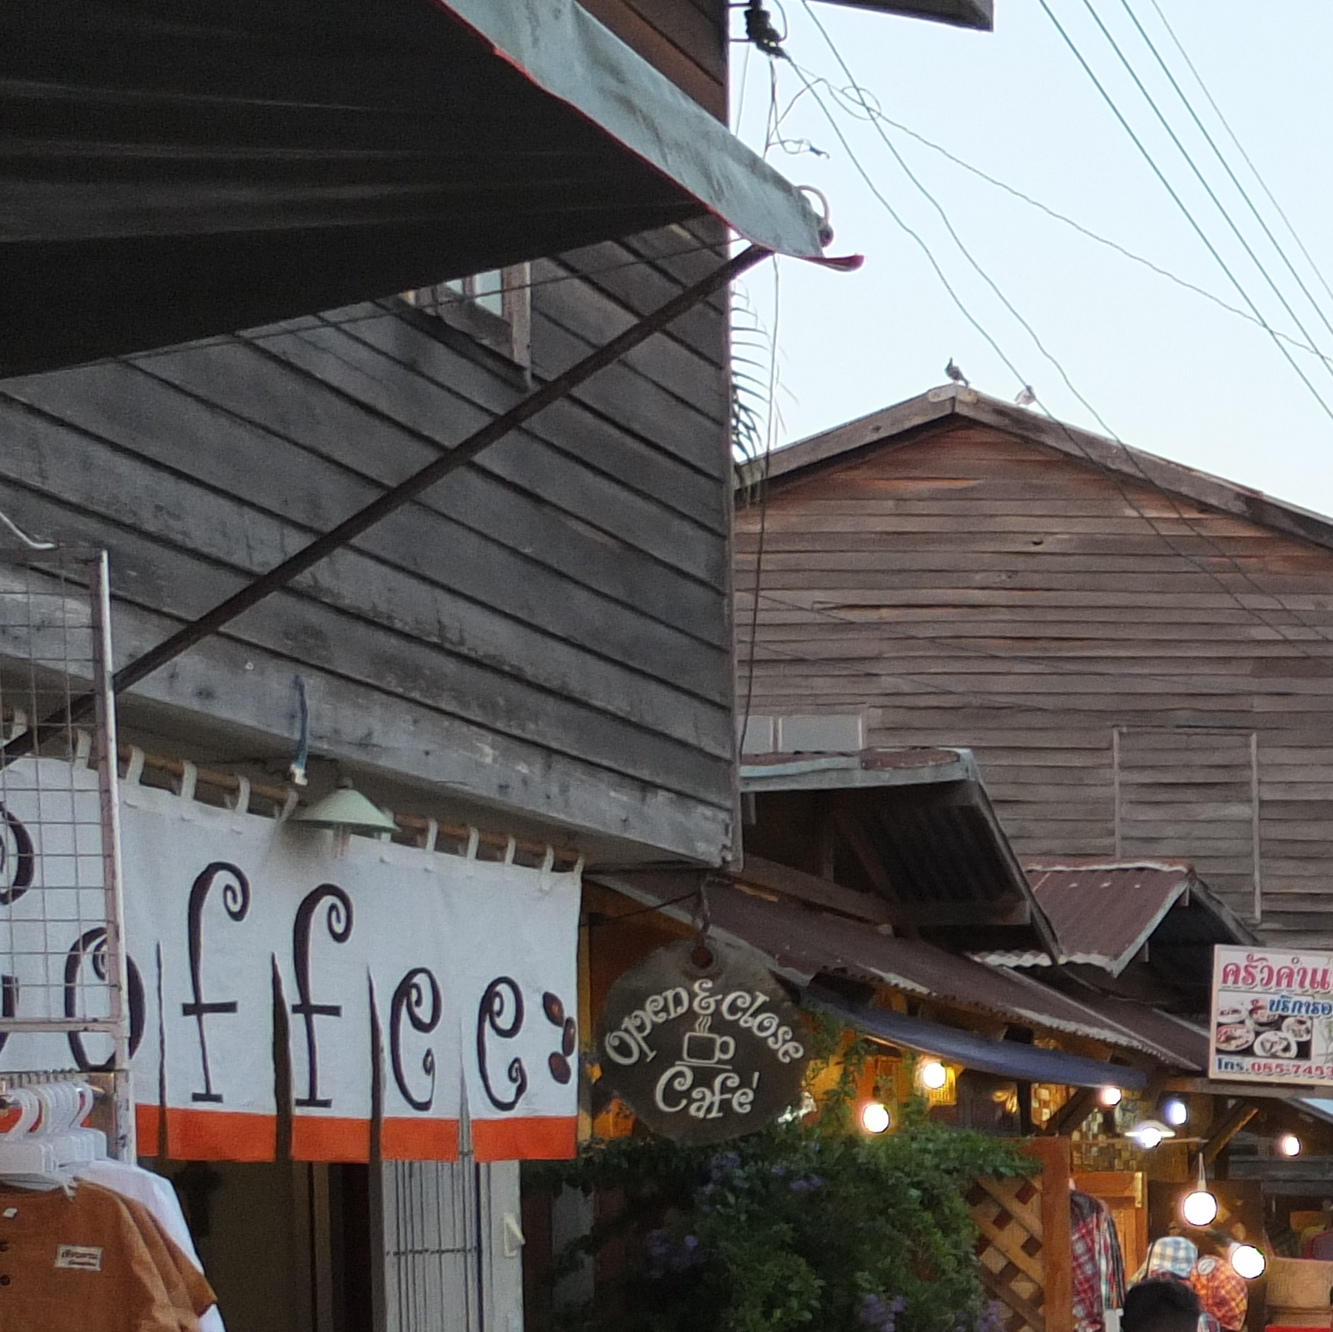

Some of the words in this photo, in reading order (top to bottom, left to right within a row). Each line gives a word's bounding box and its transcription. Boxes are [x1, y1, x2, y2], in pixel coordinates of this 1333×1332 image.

[0, 862, 527, 1112] offee
[605, 986, 690, 1066] Open
[693, 978, 724, 1015] &
